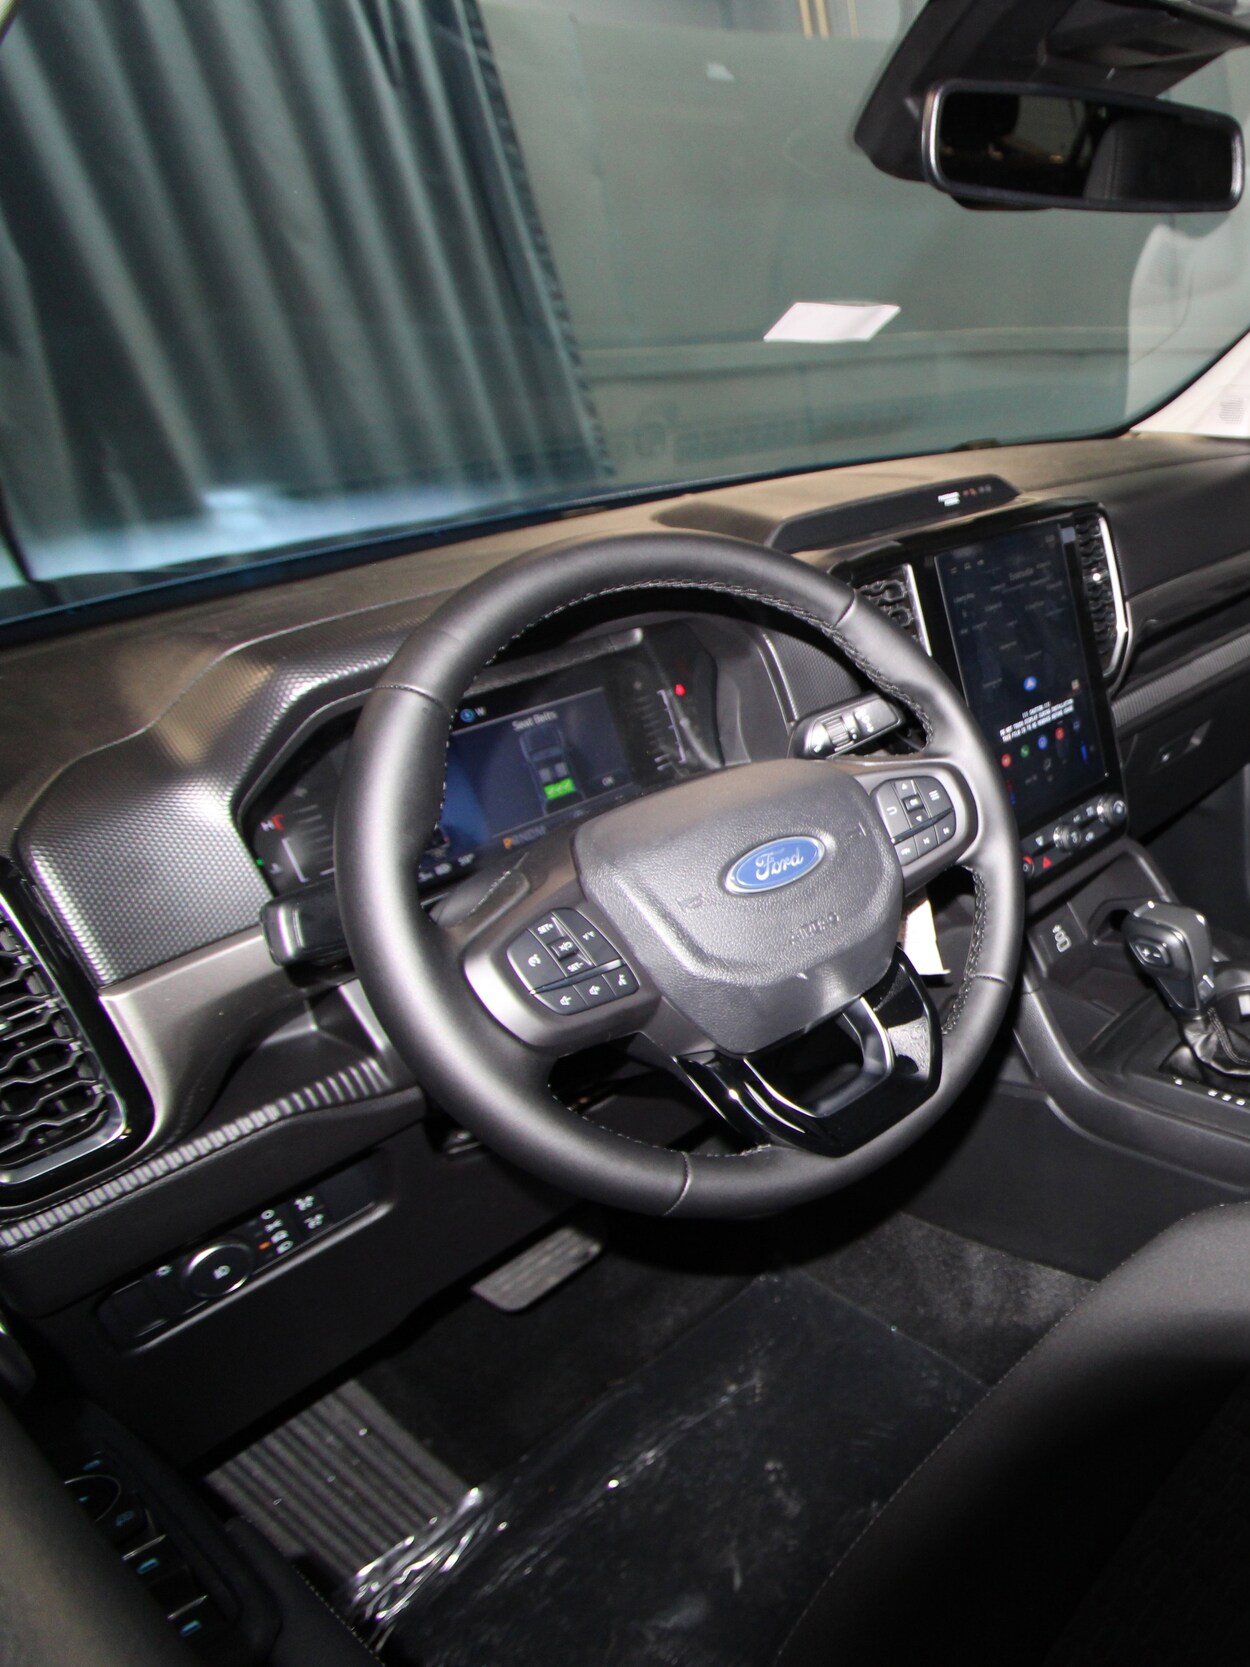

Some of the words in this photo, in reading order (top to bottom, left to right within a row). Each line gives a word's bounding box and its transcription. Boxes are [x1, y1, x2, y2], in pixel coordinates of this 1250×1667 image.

[511, 717, 534, 732] Seat
[533, 711, 559, 725] Belts
[755, 847, 804, 881] Ford
